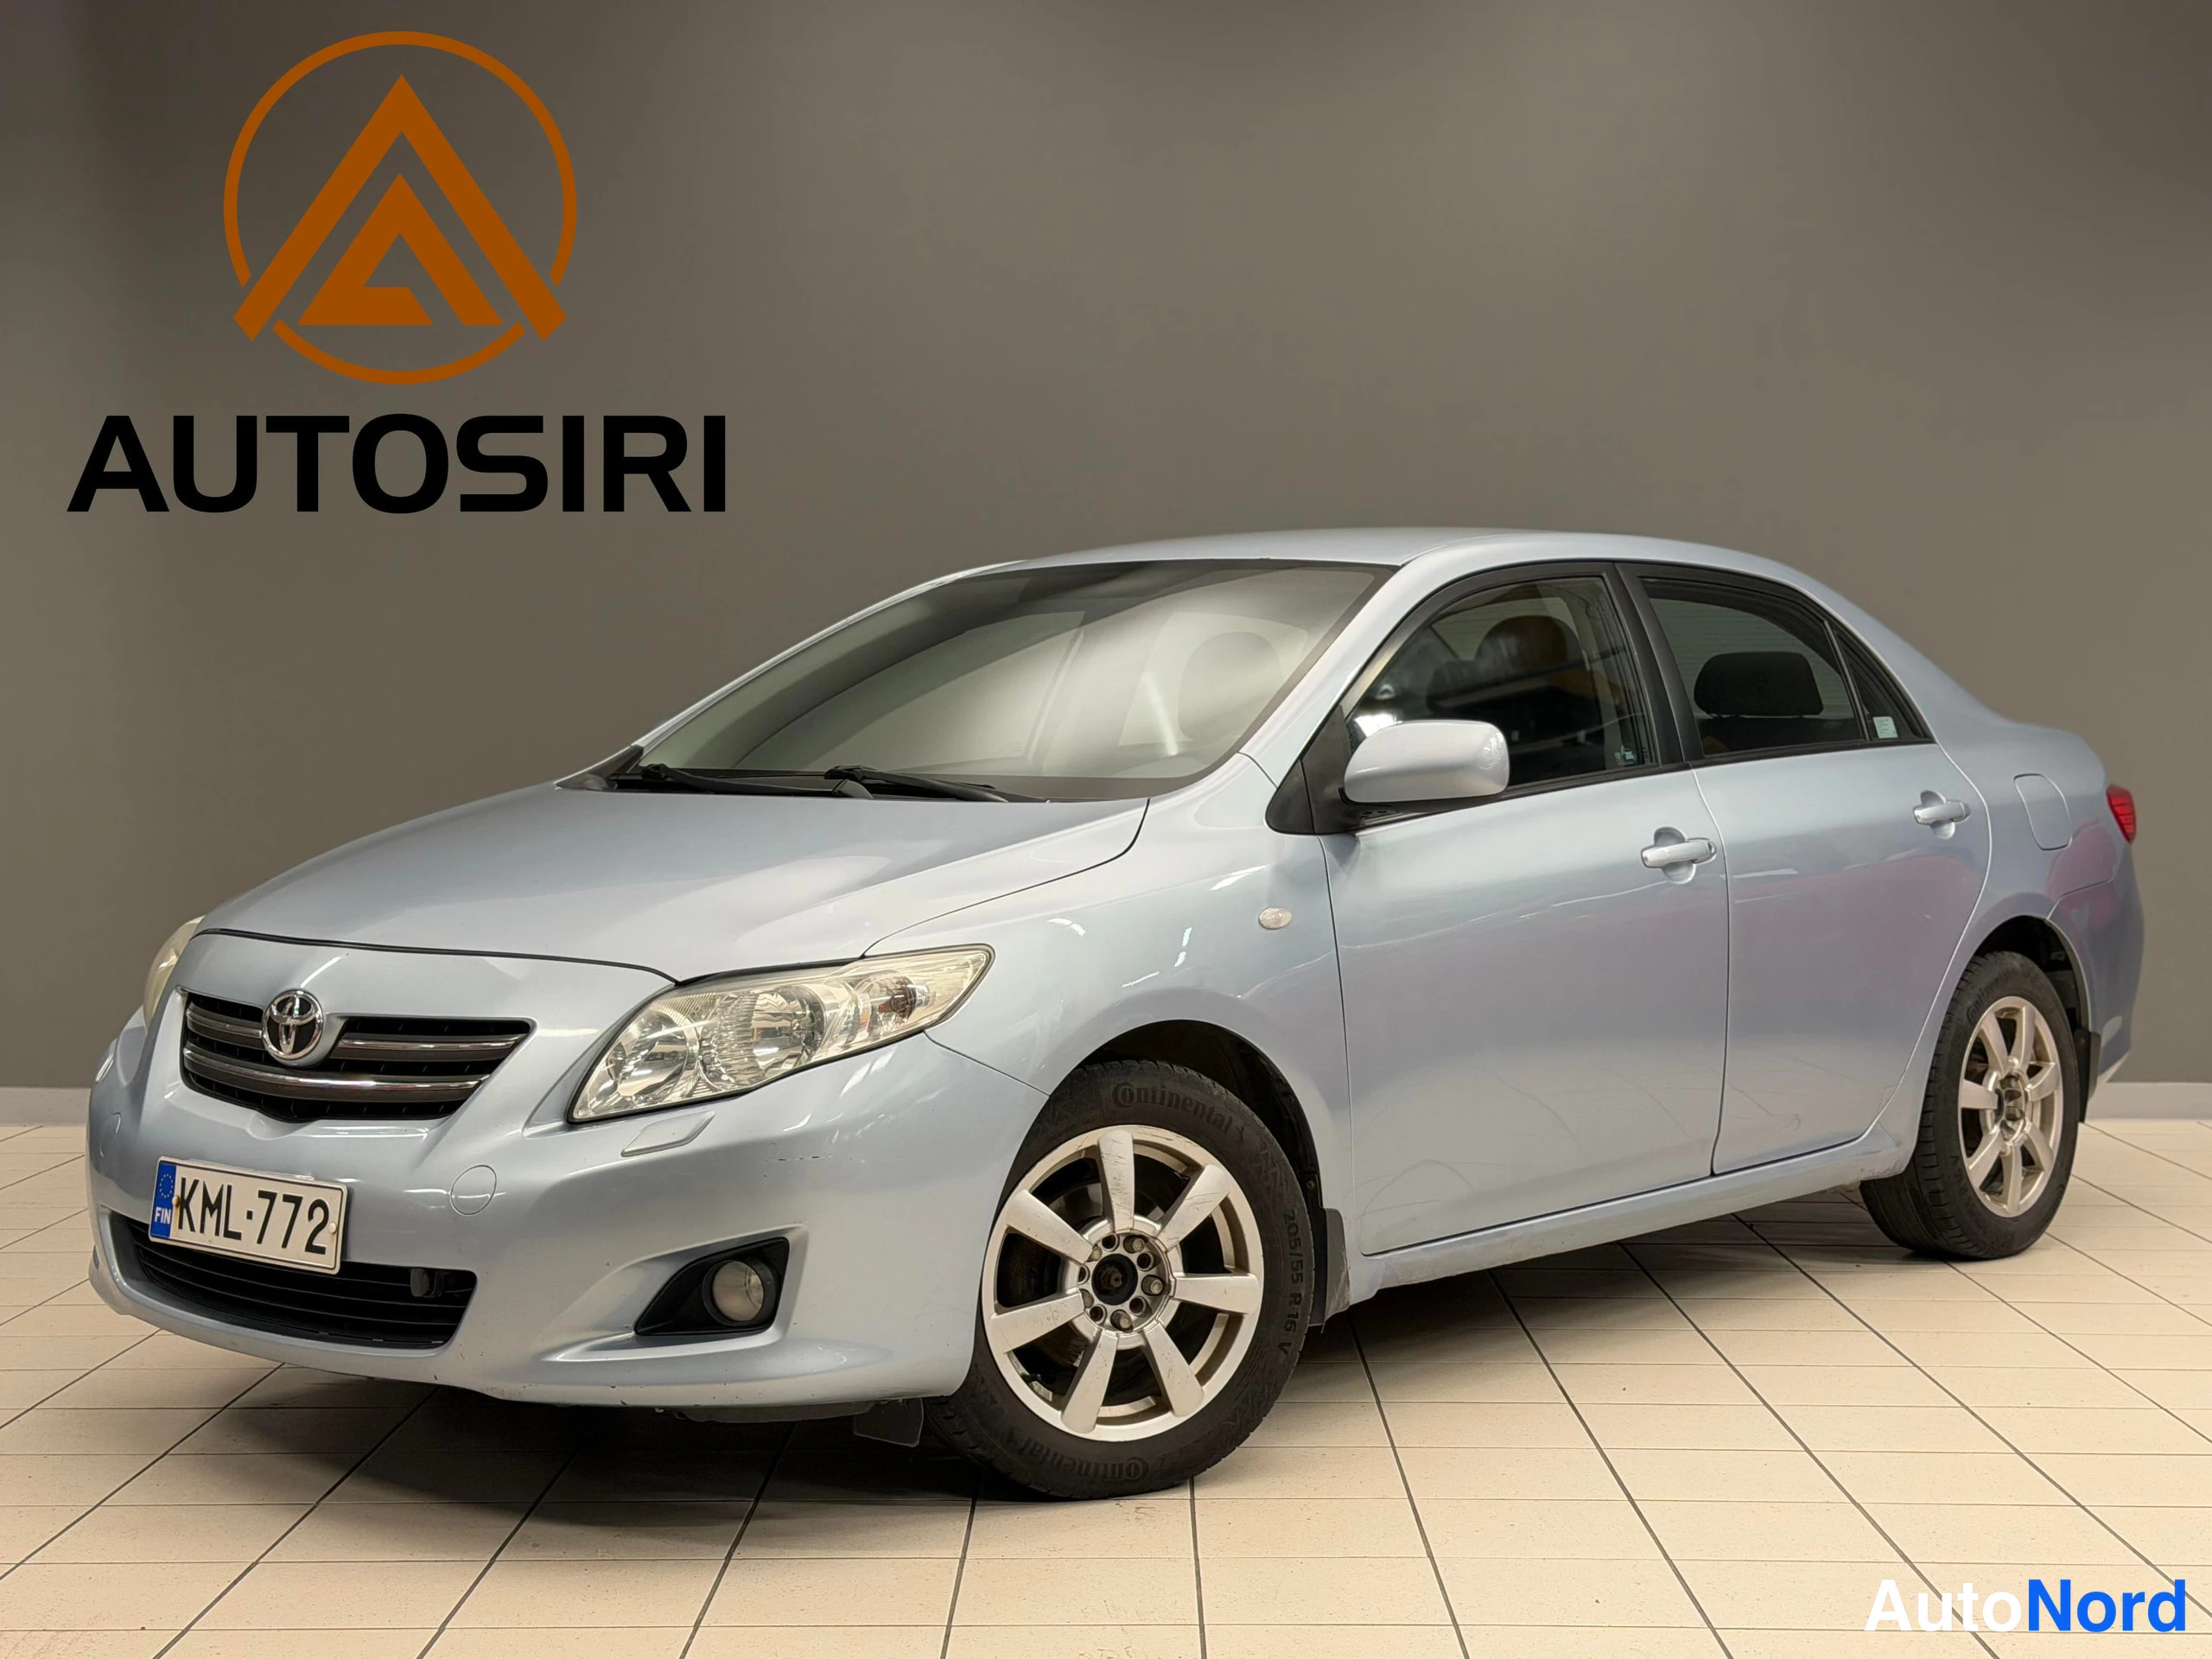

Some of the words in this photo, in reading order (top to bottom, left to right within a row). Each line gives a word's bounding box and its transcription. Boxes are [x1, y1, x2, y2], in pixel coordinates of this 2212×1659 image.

[1111, 1081, 1235, 1135] Continental
[154, 1206, 172, 1225] FIN
[1284, 1210, 1303, 1285] 205/55
